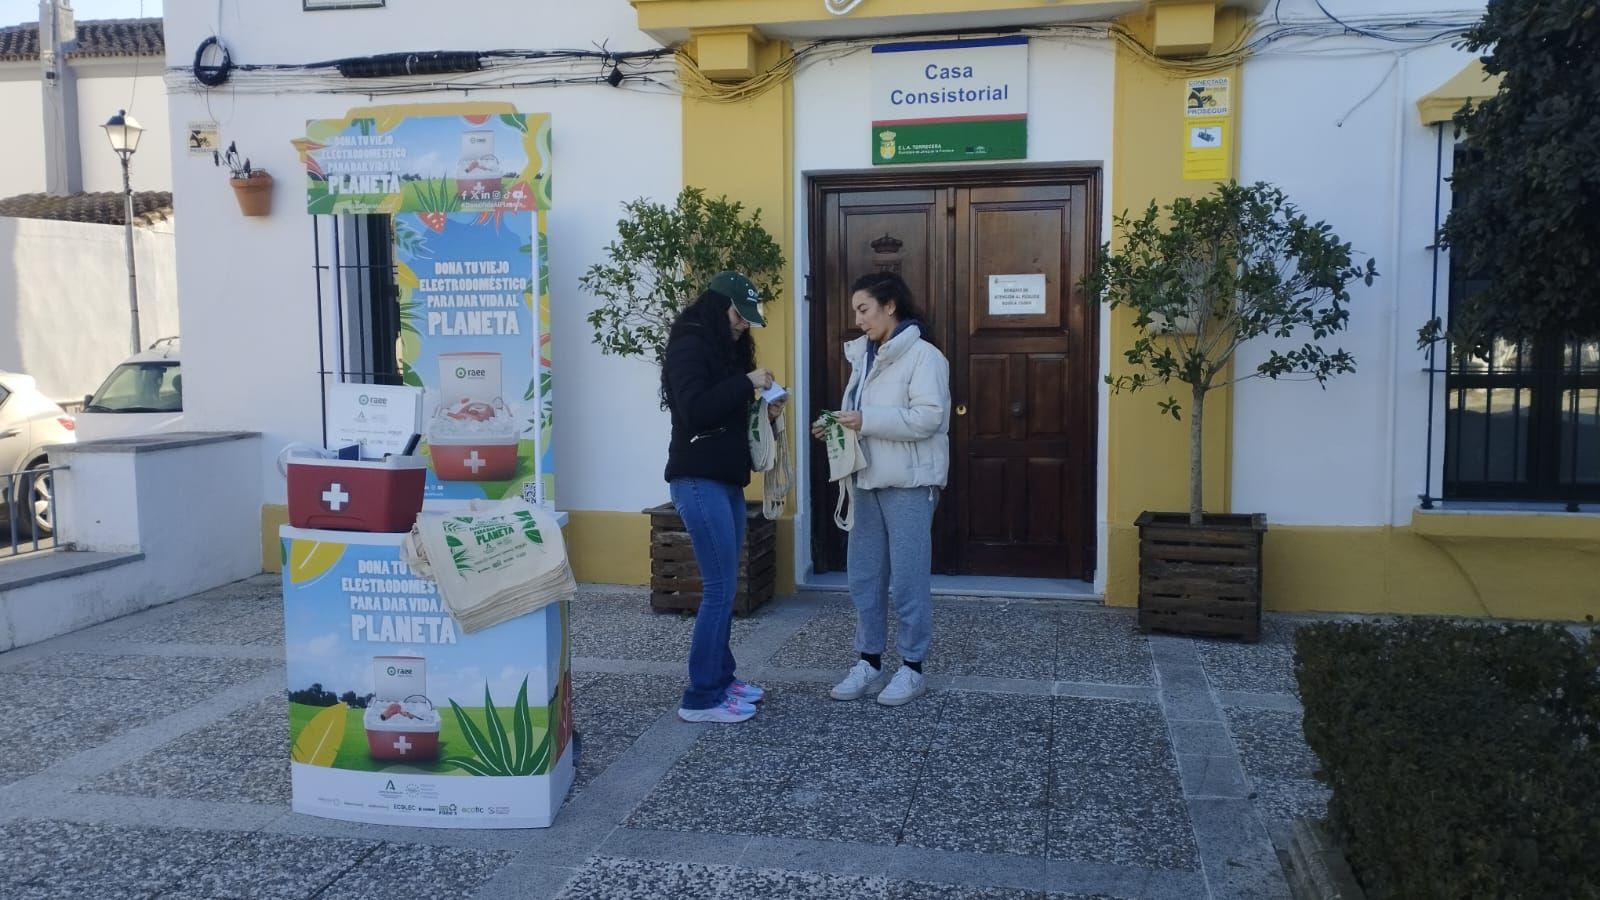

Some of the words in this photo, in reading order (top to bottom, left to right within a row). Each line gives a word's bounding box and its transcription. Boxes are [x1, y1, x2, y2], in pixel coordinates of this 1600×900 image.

[925, 64, 973, 80] Casa
[890, 84, 1008, 105] Consistorial
[357, 135, 368, 146] TU
[368, 134, 393, 146] VIEJO
[328, 174, 401, 195] PLANETA
[435, 262, 463, 274] DONA
[463, 261, 479, 274] TU
[479, 260, 510, 274] VIEJO
[419, 275, 527, 292] ELECTRODOMÉSTICO
[427, 295, 457, 308] PARA
[457, 294, 478, 308] DAR
[479, 294, 504, 308] VIDA
[503, 294, 519, 307] AL
[428, 311, 520, 336] PLANETA
[467, 369, 486, 377] raee
[370, 397, 388, 405] raee
[475, 526, 515, 546] PLANETA
[358, 559, 390, 575] DONA
[390, 560, 407, 575] TU
[350, 595, 381, 610] PARA
[382, 596, 408, 612] DAR
[408, 597, 438, 613] VIDA
[351, 614, 457, 644] PLANETA
